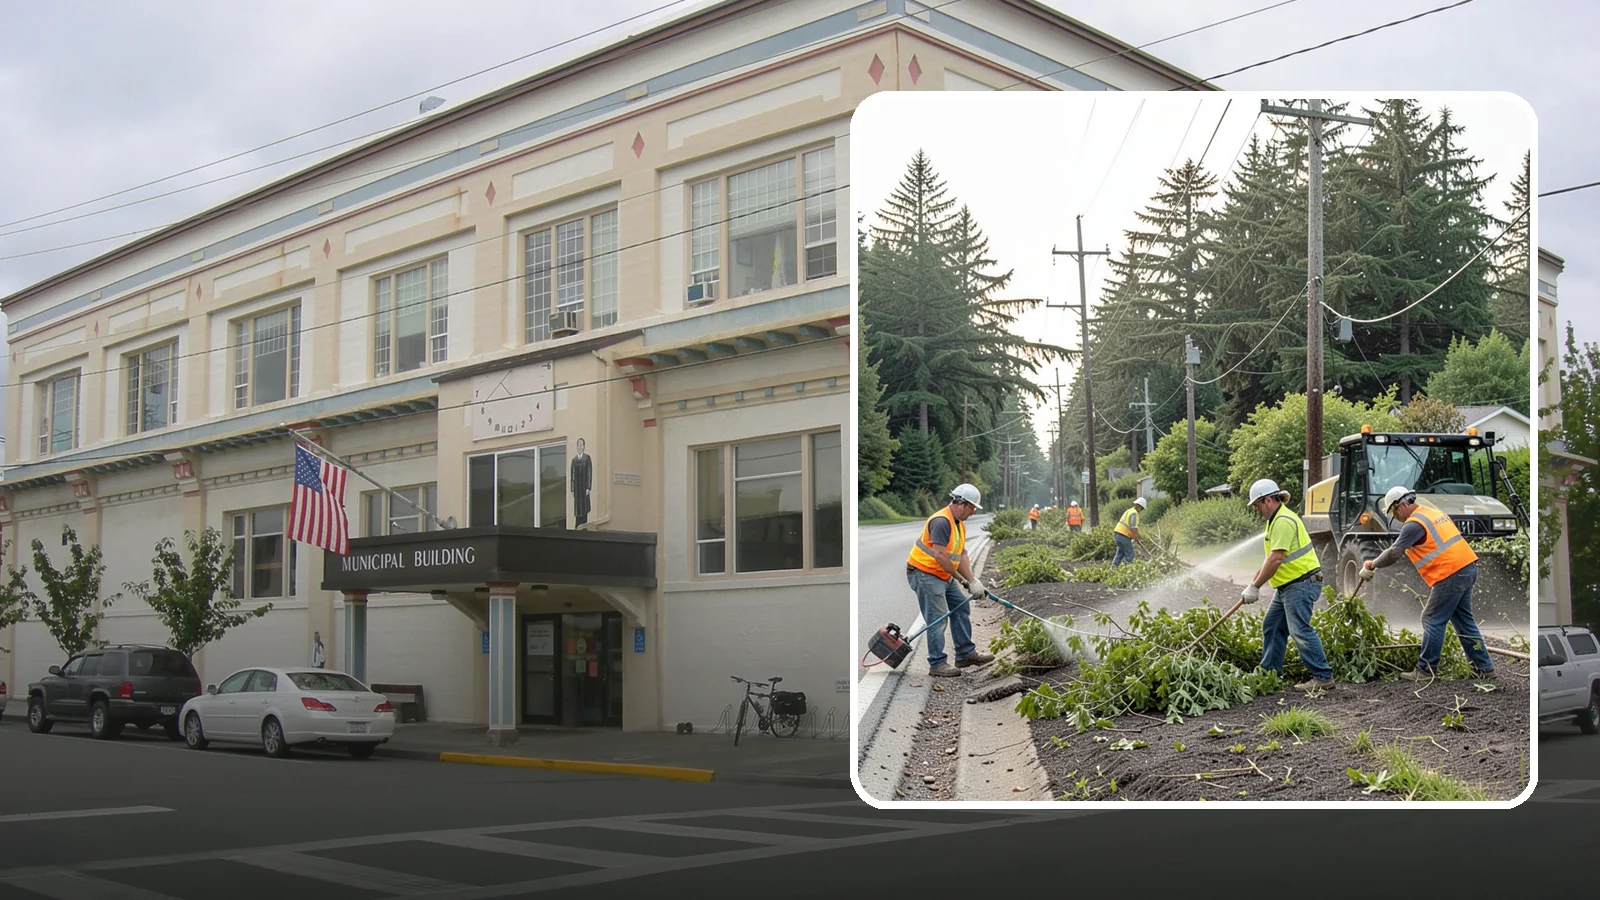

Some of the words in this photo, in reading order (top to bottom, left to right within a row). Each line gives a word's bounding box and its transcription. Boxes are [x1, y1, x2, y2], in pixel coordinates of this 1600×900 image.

[487, 417, 492, 426] 9
[520, 420, 526, 428] 2
[494, 423, 500, 432] 10
[507, 425, 513, 433] 12
[342, 552, 405, 572] MUNICIPAL
[414, 546, 475, 567] BUILDING
